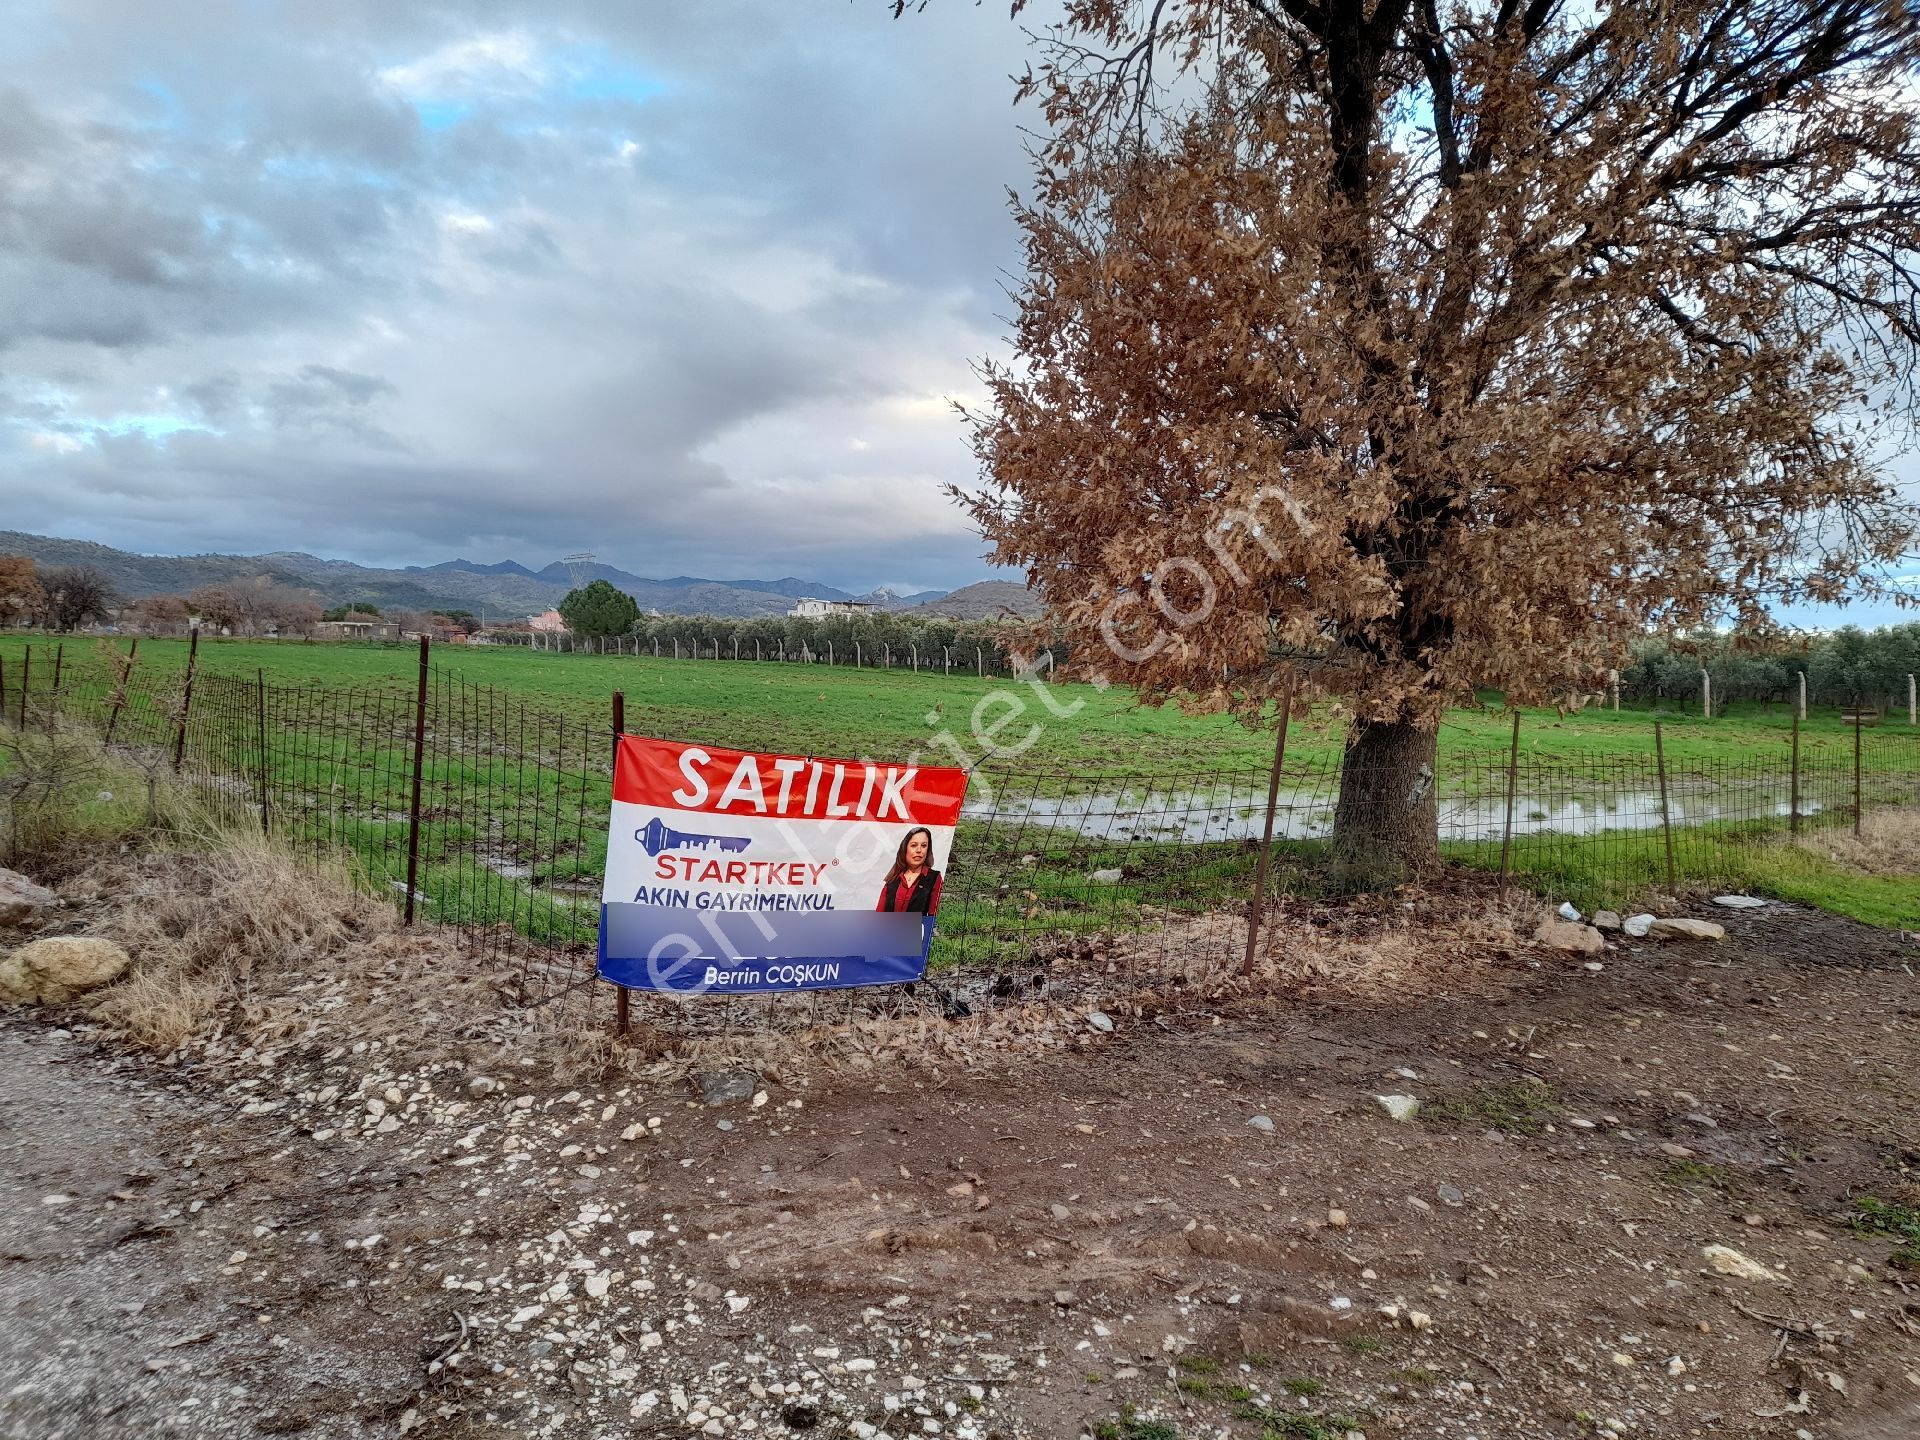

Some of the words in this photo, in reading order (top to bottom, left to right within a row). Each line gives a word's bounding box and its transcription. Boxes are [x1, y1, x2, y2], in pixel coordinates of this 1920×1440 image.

[671, 748, 919, 819] SATILIK
[633, 885, 690, 909] AKIN
[695, 887, 835, 912] GAYRİMENKUL
[704, 966, 760, 985] Berrin
[765, 963, 840, 987] COŞKUN
